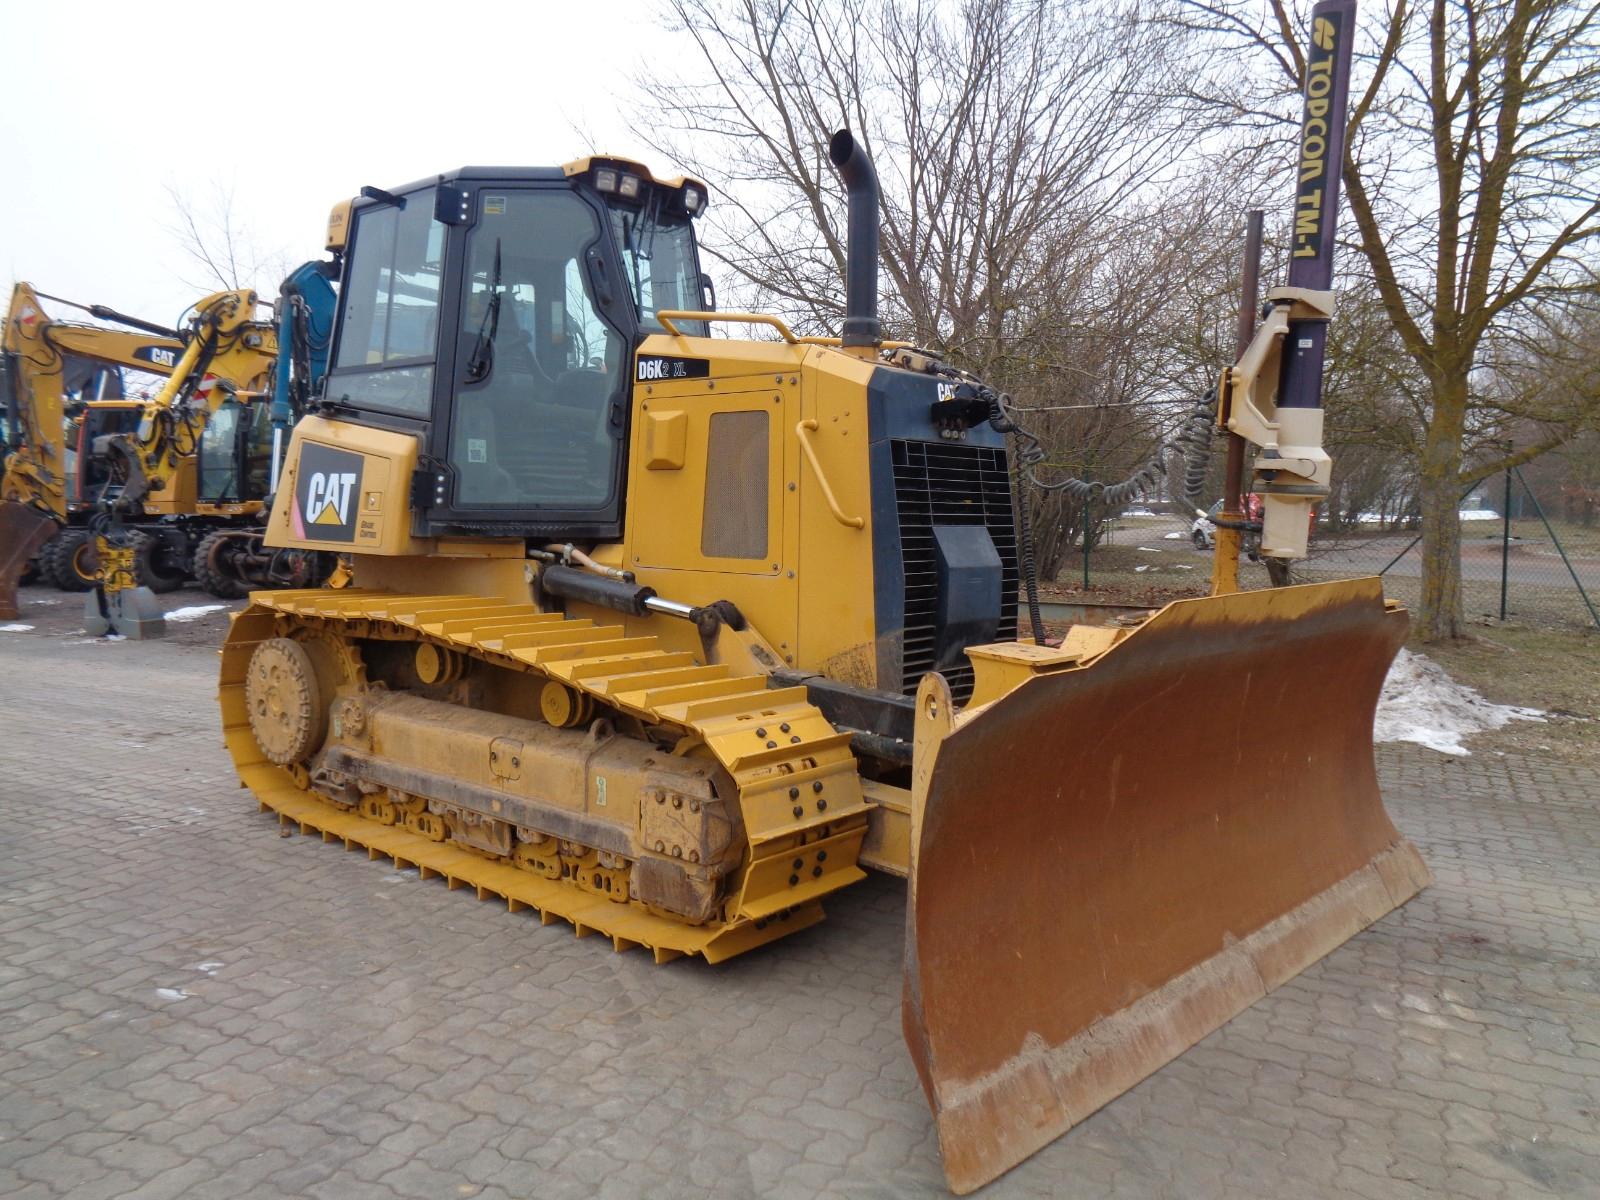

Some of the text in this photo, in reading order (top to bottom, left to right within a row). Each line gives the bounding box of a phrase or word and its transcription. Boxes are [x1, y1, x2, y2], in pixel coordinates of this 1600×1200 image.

[1293, 55, 1333, 258] TOPCON TM-1
[152, 347, 175, 366] CAT
[306, 472, 356, 525] CAT
